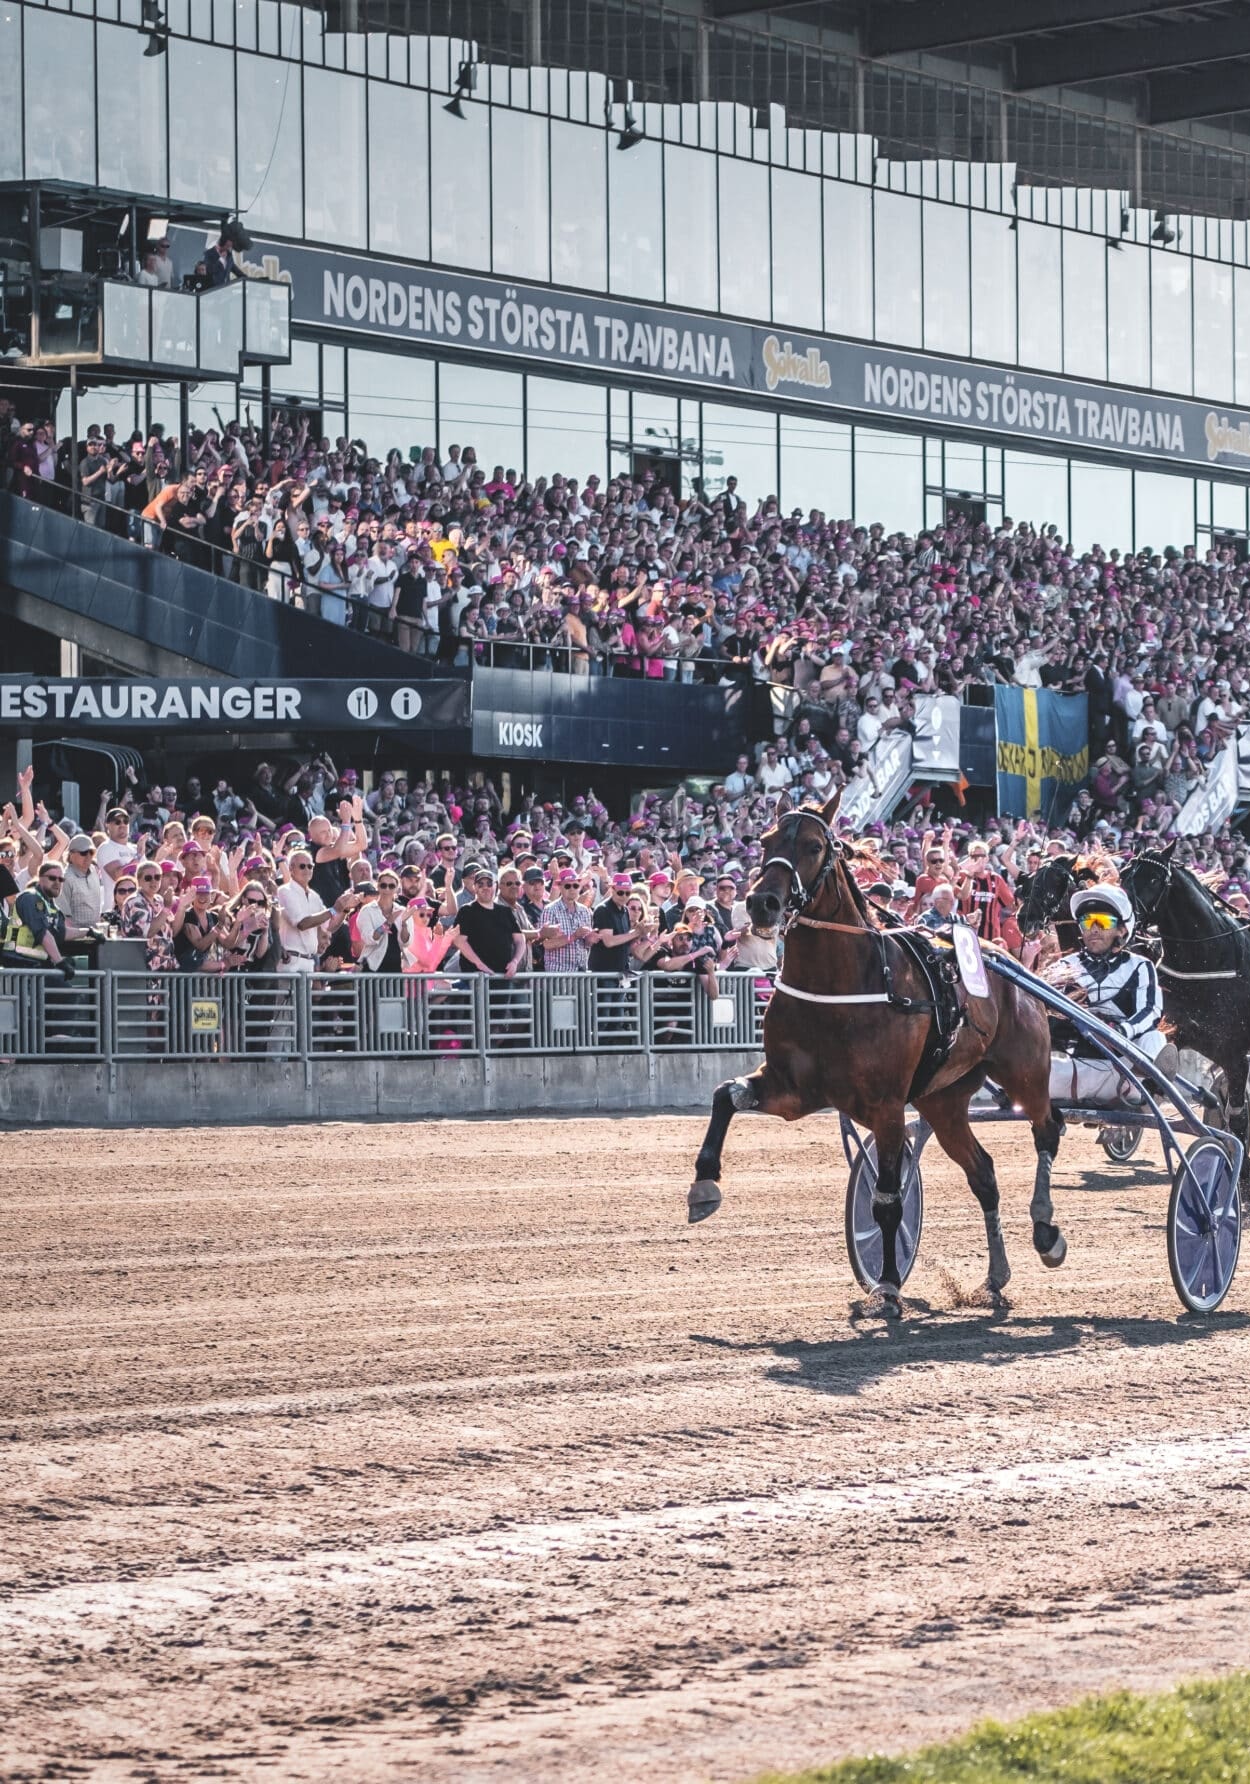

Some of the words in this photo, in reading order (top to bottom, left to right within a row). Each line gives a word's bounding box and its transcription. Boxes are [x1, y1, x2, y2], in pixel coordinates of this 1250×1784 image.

[323, 269, 462, 337] NORDENS
[468, 288, 590, 357] STÖRSTA
[594, 316, 735, 380] TRAVBANA
[763, 334, 832, 390] Solvalla
[864, 362, 972, 419] NORDENS
[976, 375, 1071, 434] STÖRSTA
[1075, 398, 1185, 453] TRAVBANA
[498, 721, 543, 748] KIOSK
[957, 930, 979, 974] 3
